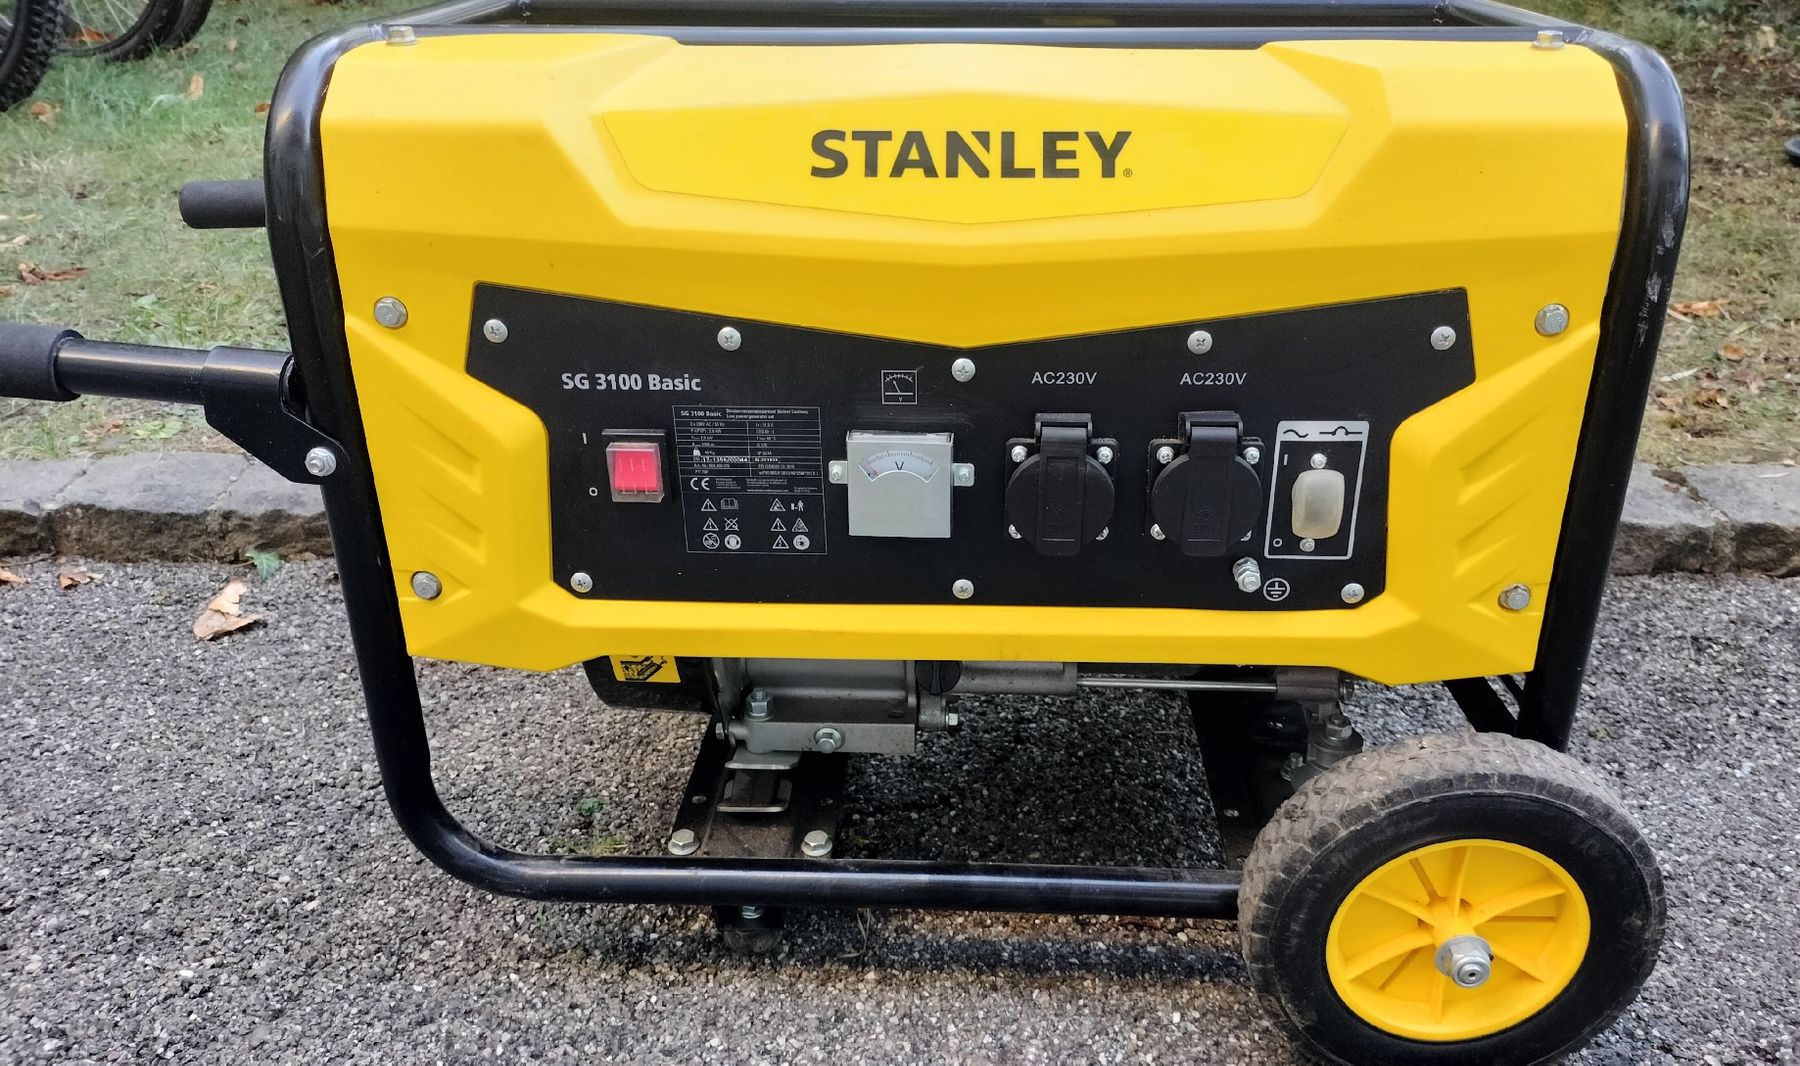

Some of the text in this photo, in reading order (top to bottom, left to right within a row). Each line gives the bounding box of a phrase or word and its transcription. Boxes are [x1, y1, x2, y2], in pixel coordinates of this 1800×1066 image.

[810, 129, 1132, 179] STANLEY
[561, 372, 702, 391] SG 3100 Basic
[1031, 371, 1098, 385] AC230V
[1179, 372, 1248, 386] AC230V
[895, 461, 904, 471] V
